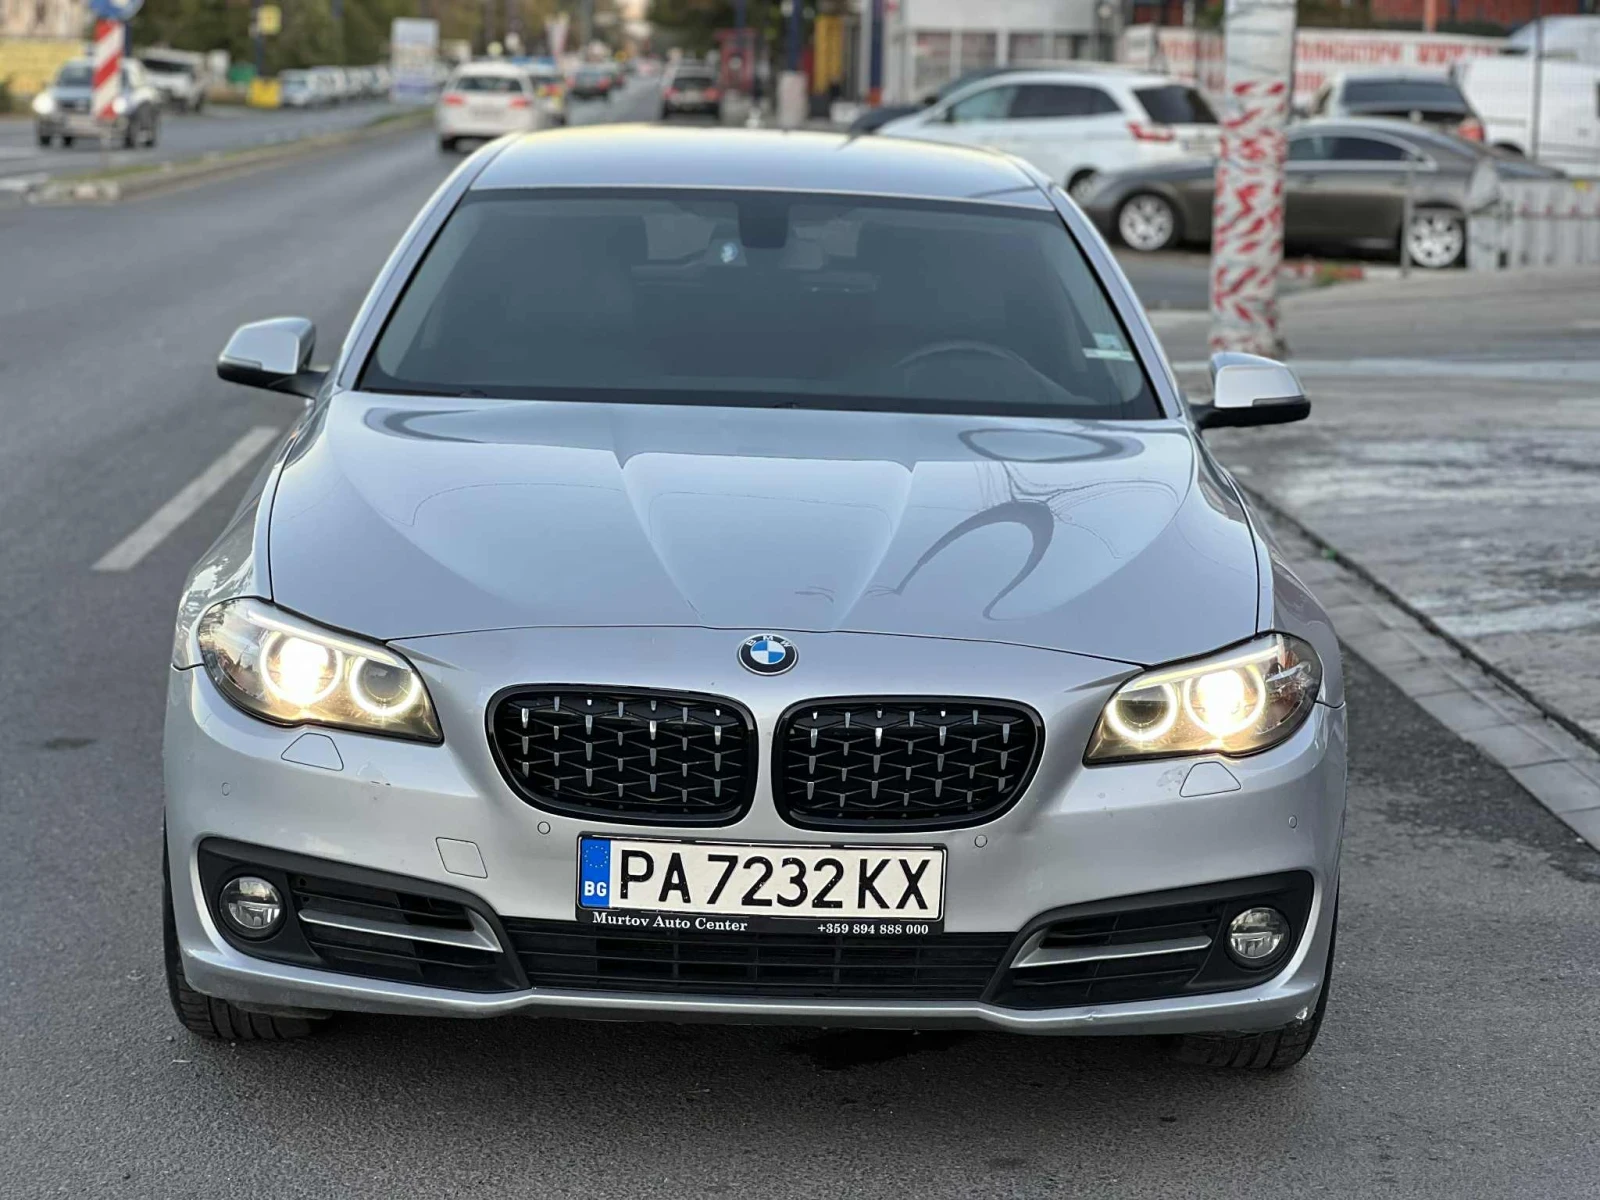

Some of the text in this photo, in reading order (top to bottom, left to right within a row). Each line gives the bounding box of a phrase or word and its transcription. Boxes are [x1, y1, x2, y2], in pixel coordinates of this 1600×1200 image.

[745, 634, 792, 648] BMW
[619, 849, 931, 910] PA 7232 KX
[583, 880, 608, 897] BG
[592, 911, 748, 932] Murtov Auto Center
[817, 923, 929, 935] +359 894 888 000
